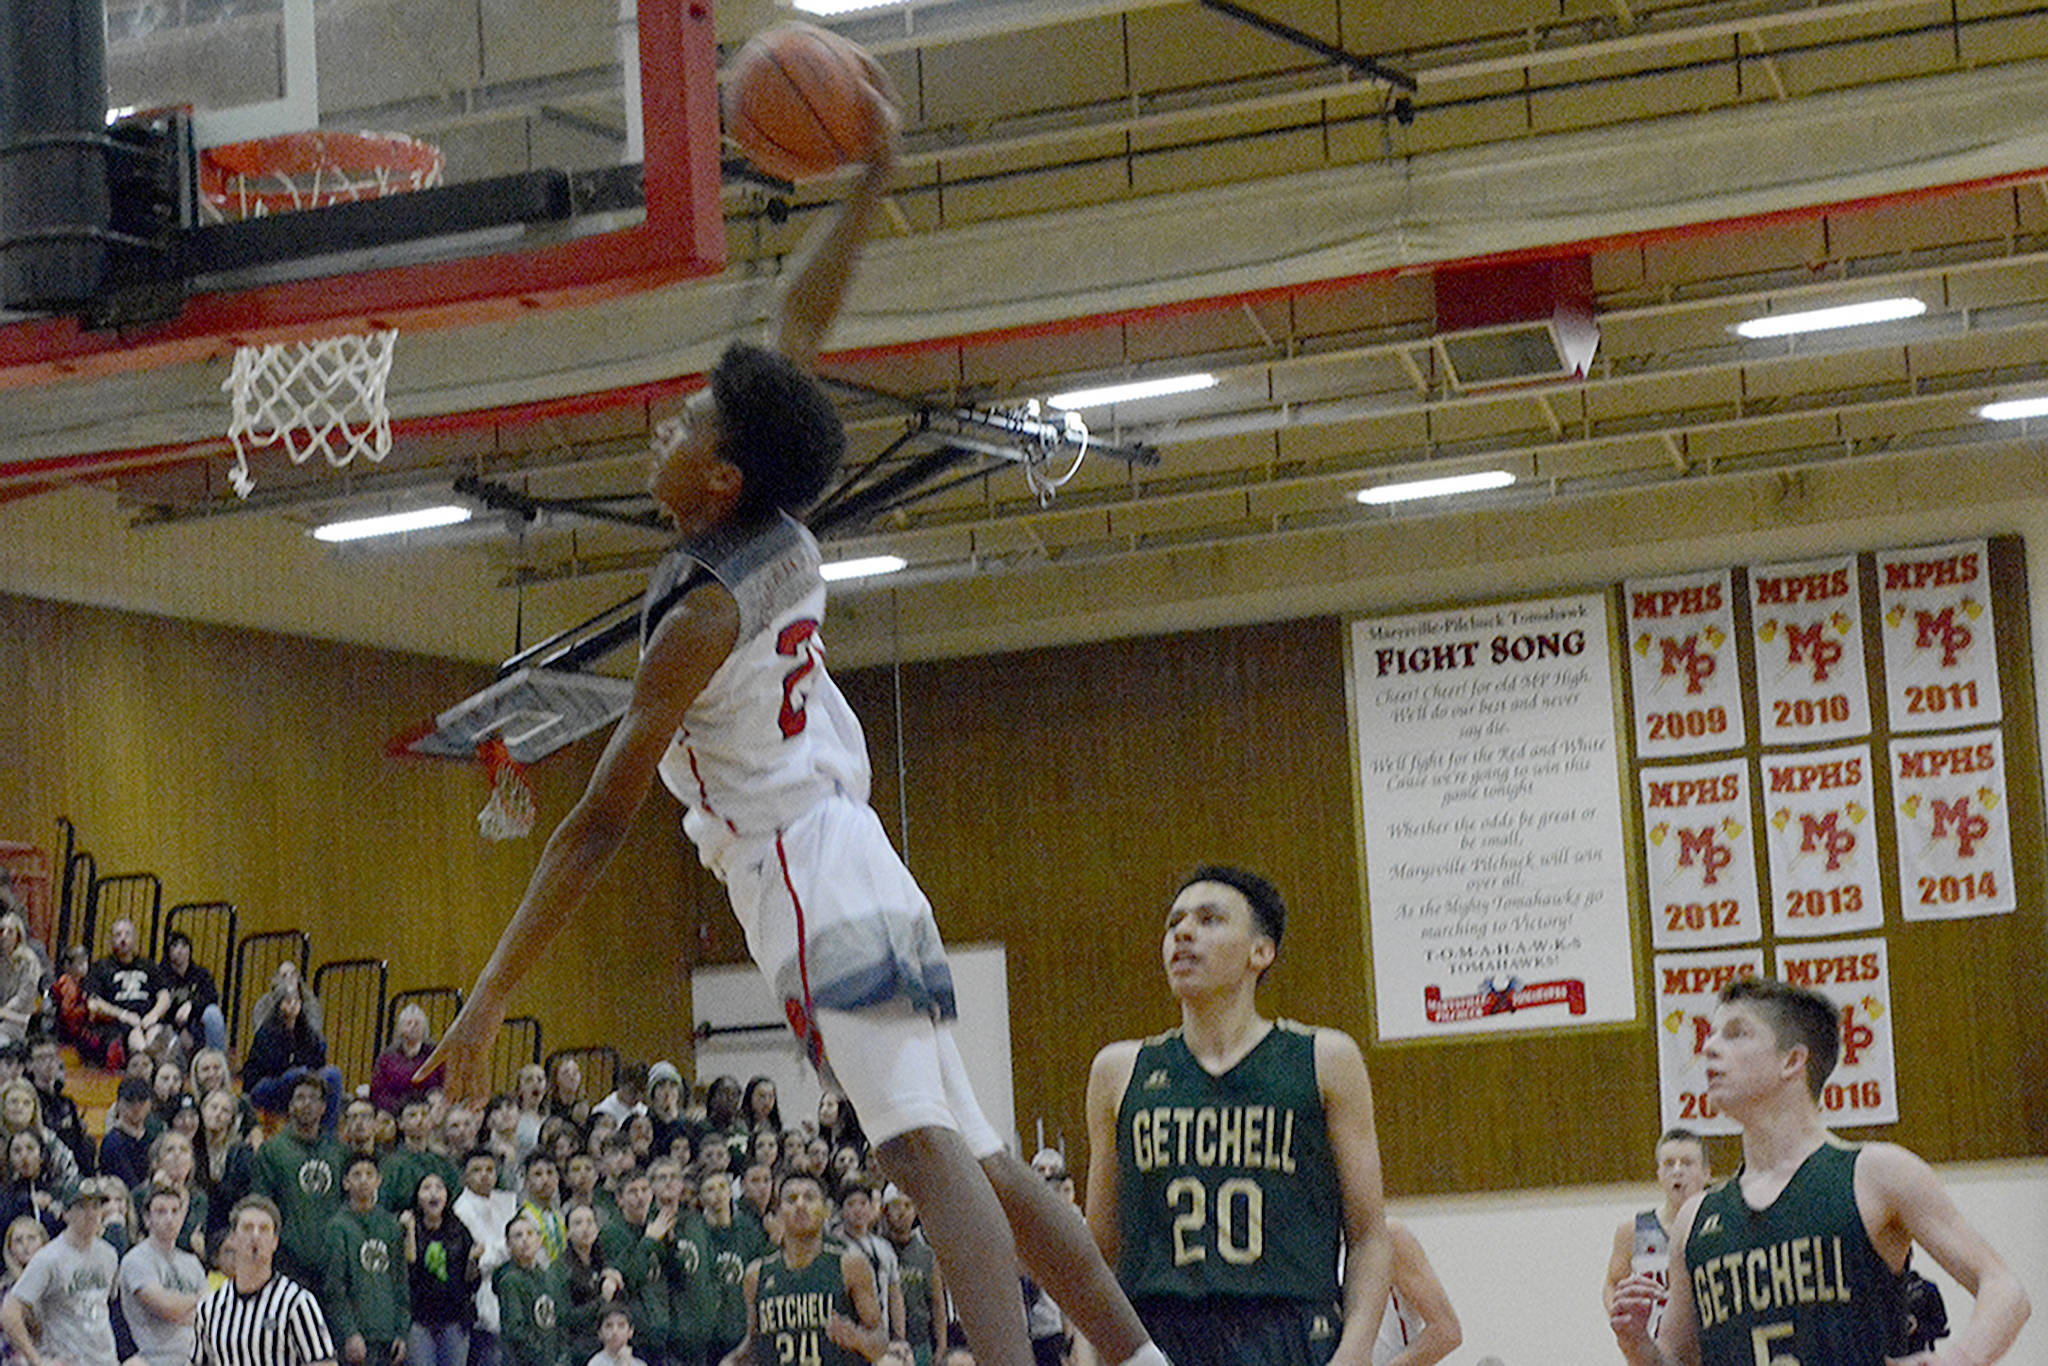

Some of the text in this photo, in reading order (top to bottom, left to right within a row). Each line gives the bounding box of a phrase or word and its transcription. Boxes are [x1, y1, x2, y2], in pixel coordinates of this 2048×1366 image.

[1755, 568, 1849, 604] MPHS
[1884, 552, 1980, 590] MPHS
[1632, 582, 1723, 619] MPHS
[1375, 628, 1586, 678] FIGHT SONG
[1470, 677, 1493, 699] for
[1494, 672, 1517, 691] old
[1904, 680, 1978, 714] 2011
[1430, 702, 1449, 720] do
[1451, 703, 1475, 718] our
[1479, 698, 1506, 714] best
[1510, 692, 1538, 712] and
[1541, 693, 1580, 708] never
[1646, 706, 1727, 740] 2009
[1772, 694, 1849, 727] 2010
[1459, 724, 1483, 741] say
[1409, 750, 1444, 775] fight
[1446, 749, 1468, 770] for
[1472, 745, 1494, 763] the
[1497, 741, 1528, 761] Red
[1529, 740, 1558, 757] and
[1560, 736, 1607, 754] White
[1468, 766, 1510, 788] going
[1513, 765, 1529, 778] to
[1533, 762, 1560, 776] win
[1564, 755, 1590, 772] this
[1897, 742, 1996, 779] MPHS
[1647, 773, 1740, 808] MPHS
[1768, 757, 1863, 793] MPHS
[1440, 786, 1478, 809] game
[1385, 807, 1597, 839] Whether the odds be great or
[1459, 834, 1477, 849] be
[1387, 846, 1603, 882] Marysville Pilchuck will win
[1465, 877, 1498, 892] over
[1917, 870, 1998, 905] 2014
[1419, 898, 1442, 917] the
[1491, 888, 1582, 912] Tomahawks
[1584, 889, 1605, 909] go
[1664, 899, 1741, 933] 2012
[1786, 885, 1864, 919] 2013
[1421, 920, 1489, 940] marching
[1492, 919, 1508, 933] to
[1784, 953, 1880, 989] MPHS
[1131, 1104, 1297, 1175] GETCHELL
[1165, 1175, 1264, 1268] 20
[1693, 1234, 1852, 1331] GETCHELL
[758, 1291, 834, 1335] GETCHELL
